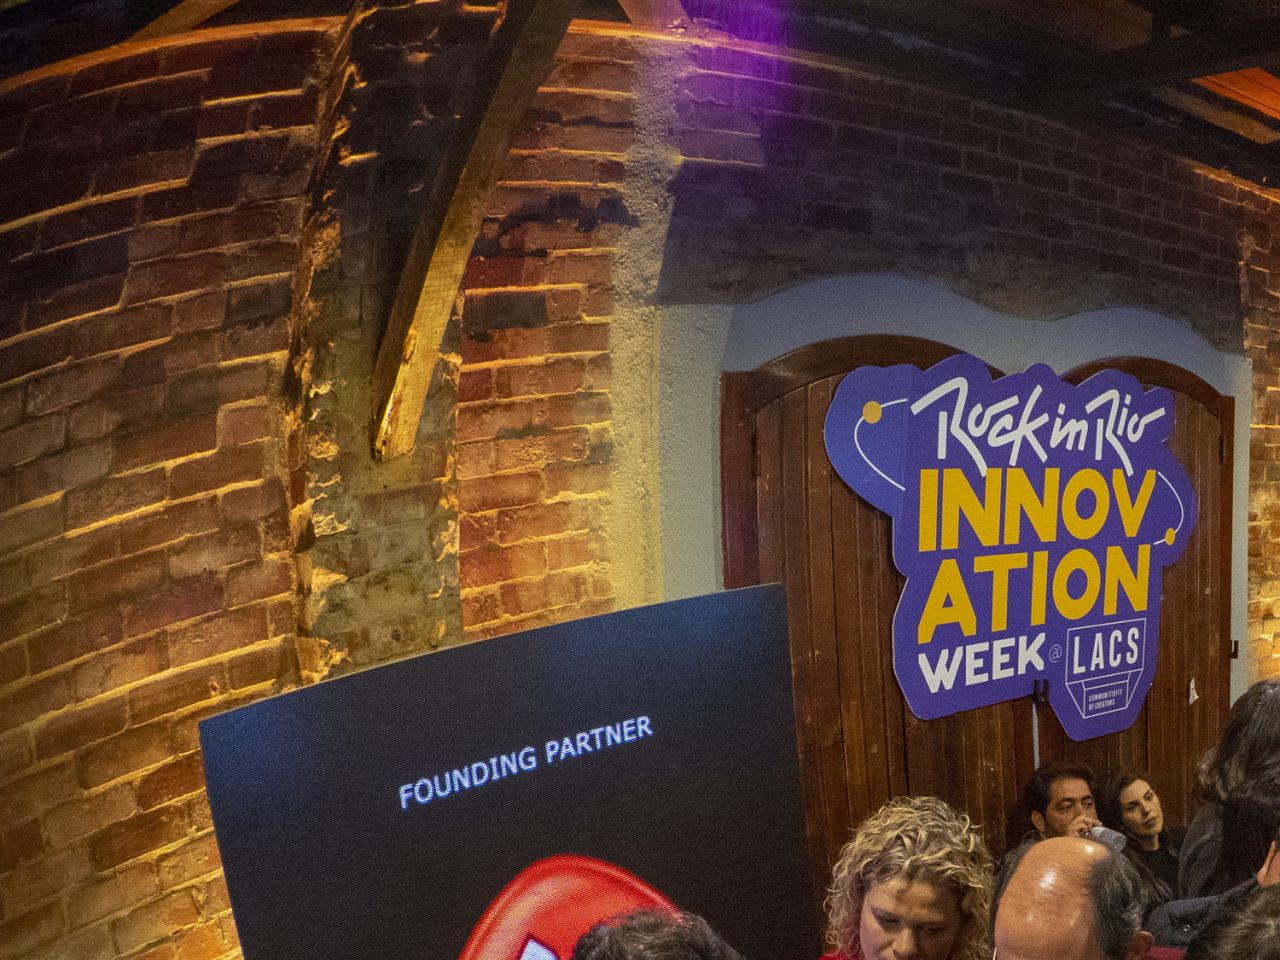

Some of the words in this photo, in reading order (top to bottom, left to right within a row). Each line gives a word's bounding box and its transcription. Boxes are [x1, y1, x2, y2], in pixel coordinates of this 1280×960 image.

[911, 377, 1049, 477] Rock
[1050, 403, 1088, 451] in
[1085, 389, 1165, 477] Rio
[918, 467, 1157, 553] INNOV
[917, 543, 1151, 645] ATION
[917, 632, 1046, 694] WEEK
[1073, 627, 1140, 675] LACS
[398, 746, 537, 811] FOUNDING
[545, 714, 653, 765] PARTNER
